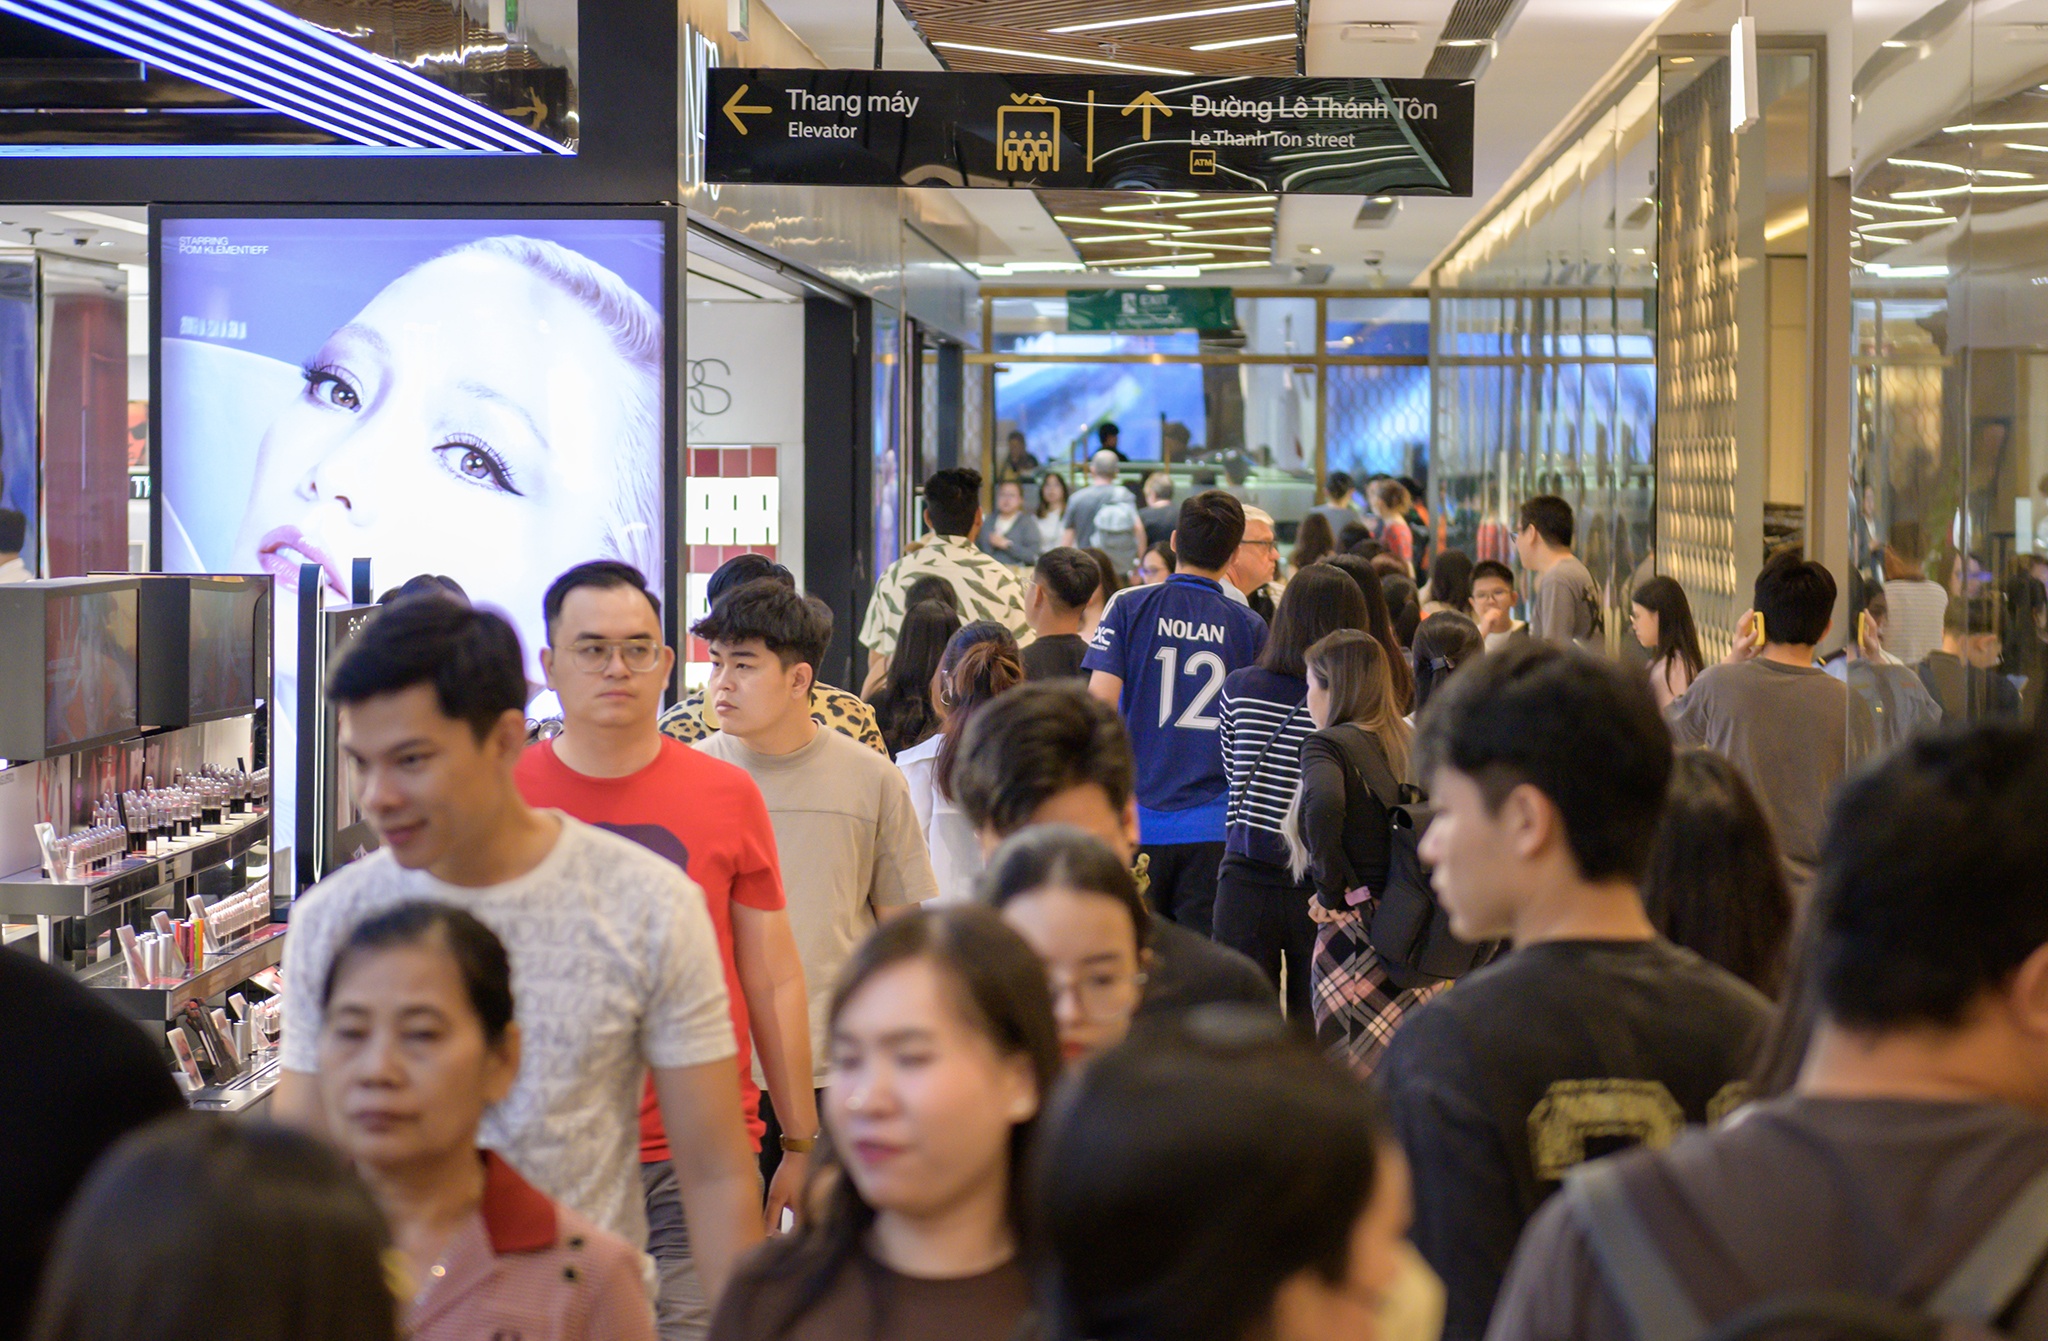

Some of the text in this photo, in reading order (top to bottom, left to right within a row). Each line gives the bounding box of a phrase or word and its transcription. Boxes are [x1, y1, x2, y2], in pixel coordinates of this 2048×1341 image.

[785, 88, 920, 118] Thang máy
[1190, 95, 1438, 123] Đường Lê Thánh Tôn
[788, 121, 858, 139] Elevator
[1191, 130, 1356, 148] Le Thanh Ton street
[1193, 158, 1214, 167] ATM
[179, 236, 229, 246] STARRING
[179, 245, 269, 255] POM KLEMENTIEFF
[1157, 617, 1225, 645] NOLAN
[1154, 646, 1227, 731] 12
